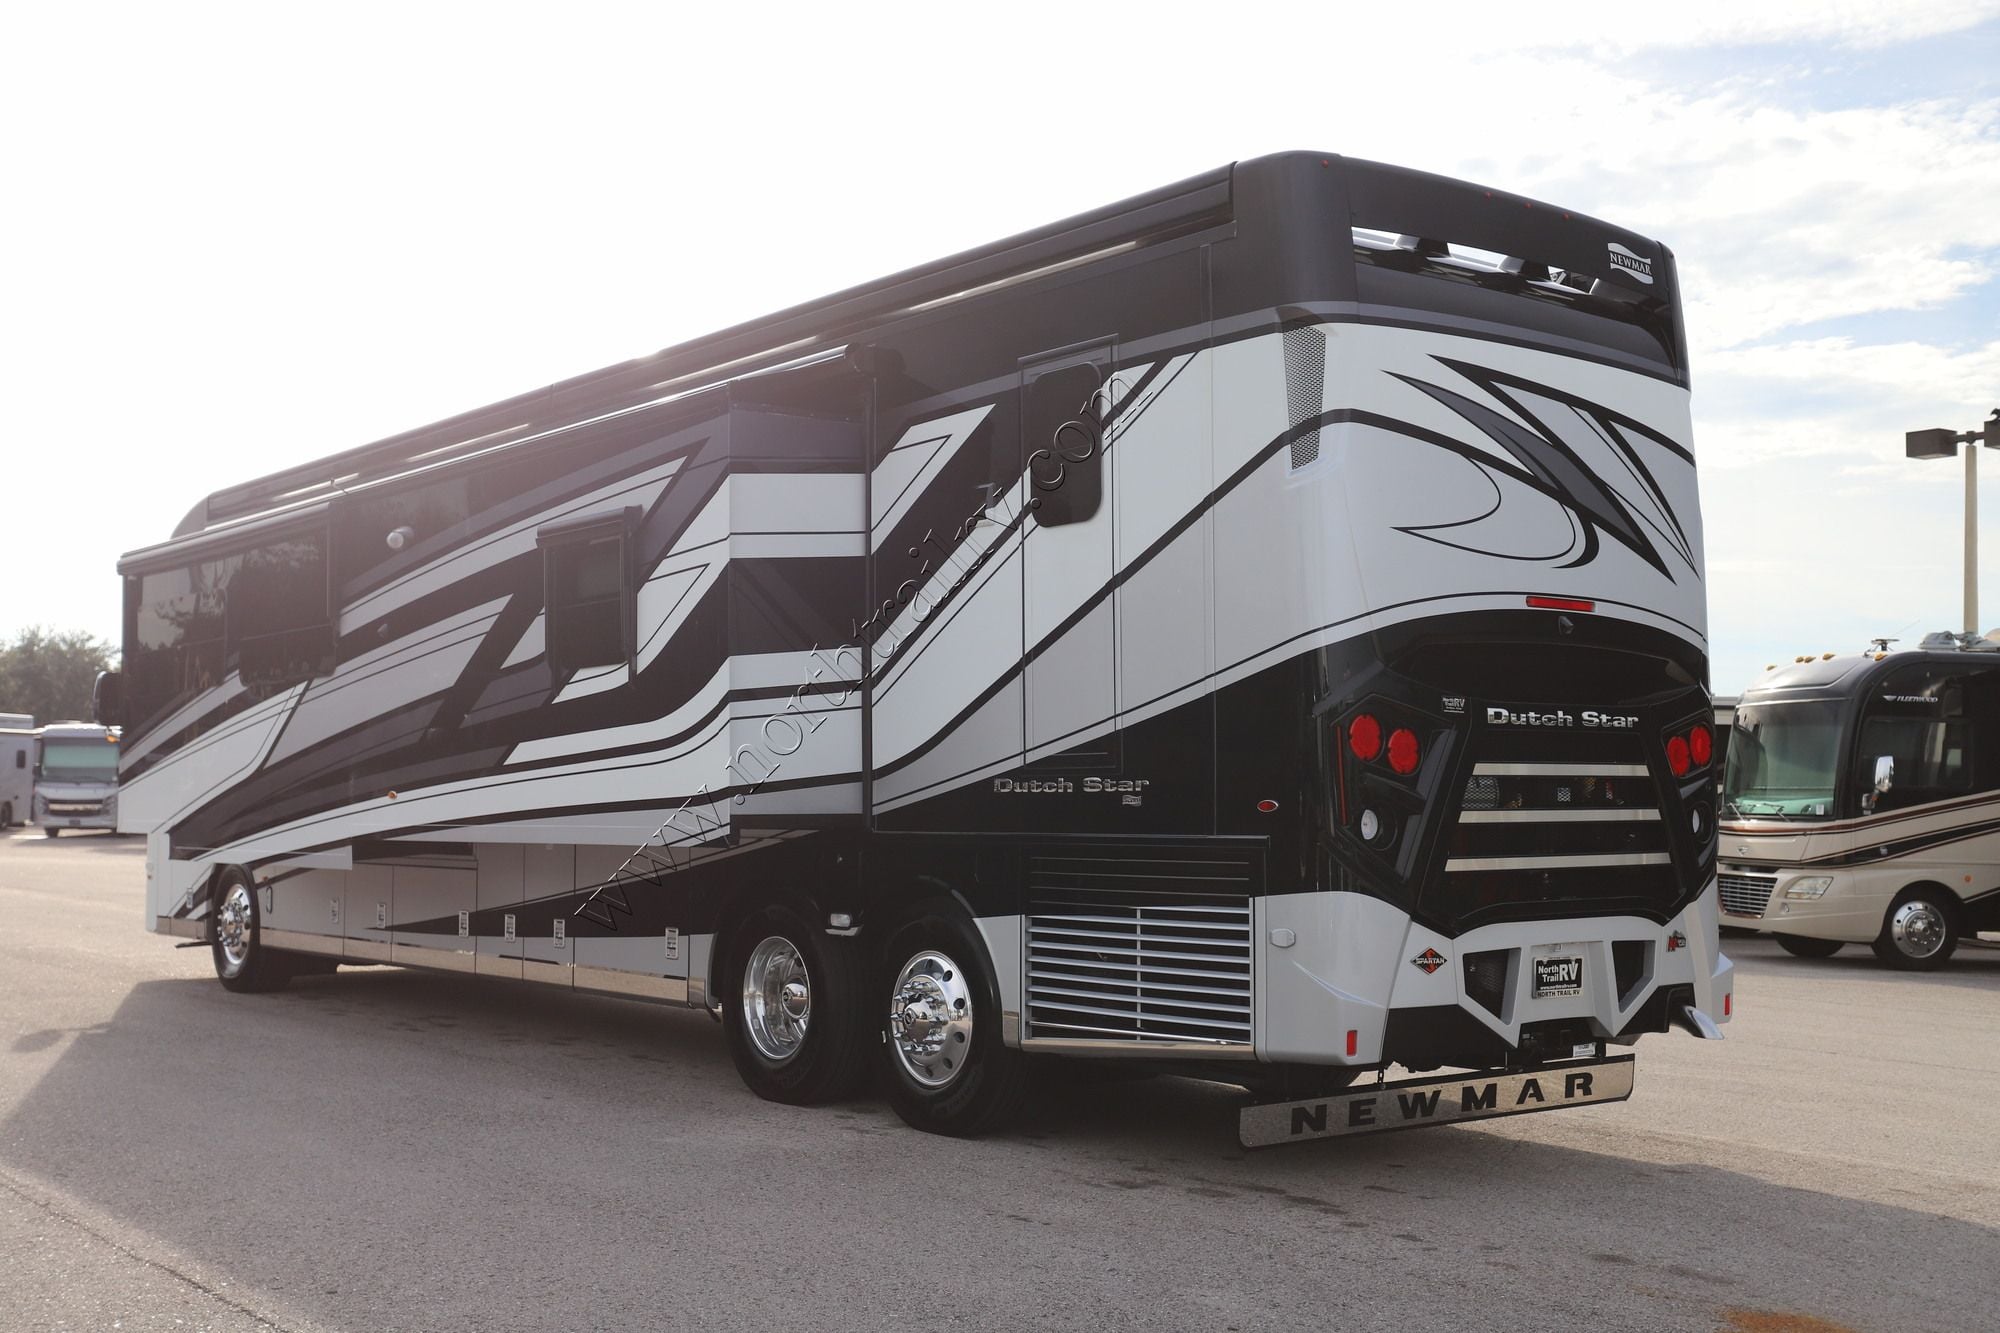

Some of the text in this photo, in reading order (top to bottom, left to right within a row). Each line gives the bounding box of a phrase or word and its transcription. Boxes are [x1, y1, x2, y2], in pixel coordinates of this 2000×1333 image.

[1610, 252, 1652, 275] NEWMAR
[1896, 695, 1938, 703] FLEETWOOD
[1486, 708, 1640, 729] Dutch Star
[993, 777, 1150, 793] Dutch Star
[1415, 957, 1445, 965] SPARTAN
[1538, 964, 1559, 974] North
[1542, 973, 1559, 983] Trail
[1559, 963, 1579, 982] RV
[1290, 1071, 1594, 1135] NEWMAR
